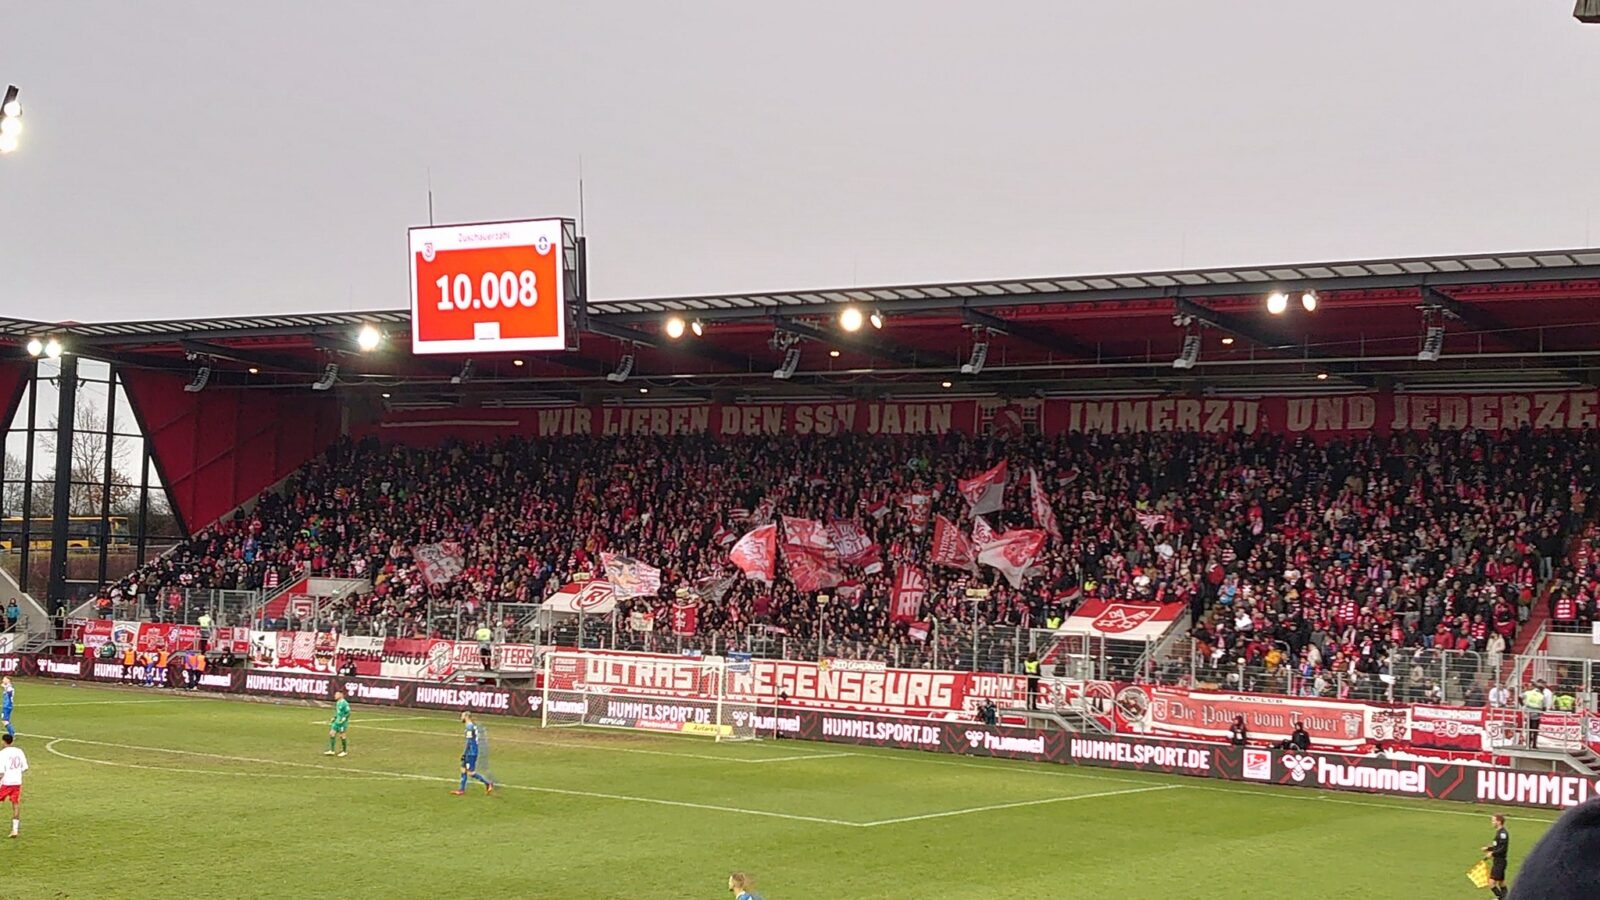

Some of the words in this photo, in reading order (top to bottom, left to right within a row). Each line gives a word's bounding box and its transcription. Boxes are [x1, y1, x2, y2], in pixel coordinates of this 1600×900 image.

[435, 270, 538, 311] 10.008
[538, 408, 592, 437] WIR
[603, 406, 709, 437] LIEBEN
[721, 406, 783, 436] DEN
[795, 404, 856, 434] SSV
[867, 403, 952, 434] JAHN
[1069, 400, 1259, 435] IMMERZU
[1287, 398, 1376, 432] UND
[246, 674, 330, 696] HUMMELSPORT.DE
[358, 682, 400, 700] hummel
[416, 686, 510, 709] HUMMELSPORT.DE
[586, 658, 692, 691] ULTRAS
[733, 662, 955, 708] REGENSBURG
[970, 676, 1014, 698] JAHN
[607, 700, 712, 725] HUMMELSPORTDE
[1230, 695, 1283, 704] FANCLUB
[822, 717, 941, 745] HUMMELSPORT.DE
[1171, 702, 1196, 719] Die
[1254, 711, 1284, 728] vom
[1289, 710, 1339, 732] Tower
[984, 730, 1045, 754] hummel
[1071, 739, 1211, 770] HUMMELSPORT.DE
[1317, 756, 1426, 794] hummel
[1477, 770, 1600, 807] HUMMEL
